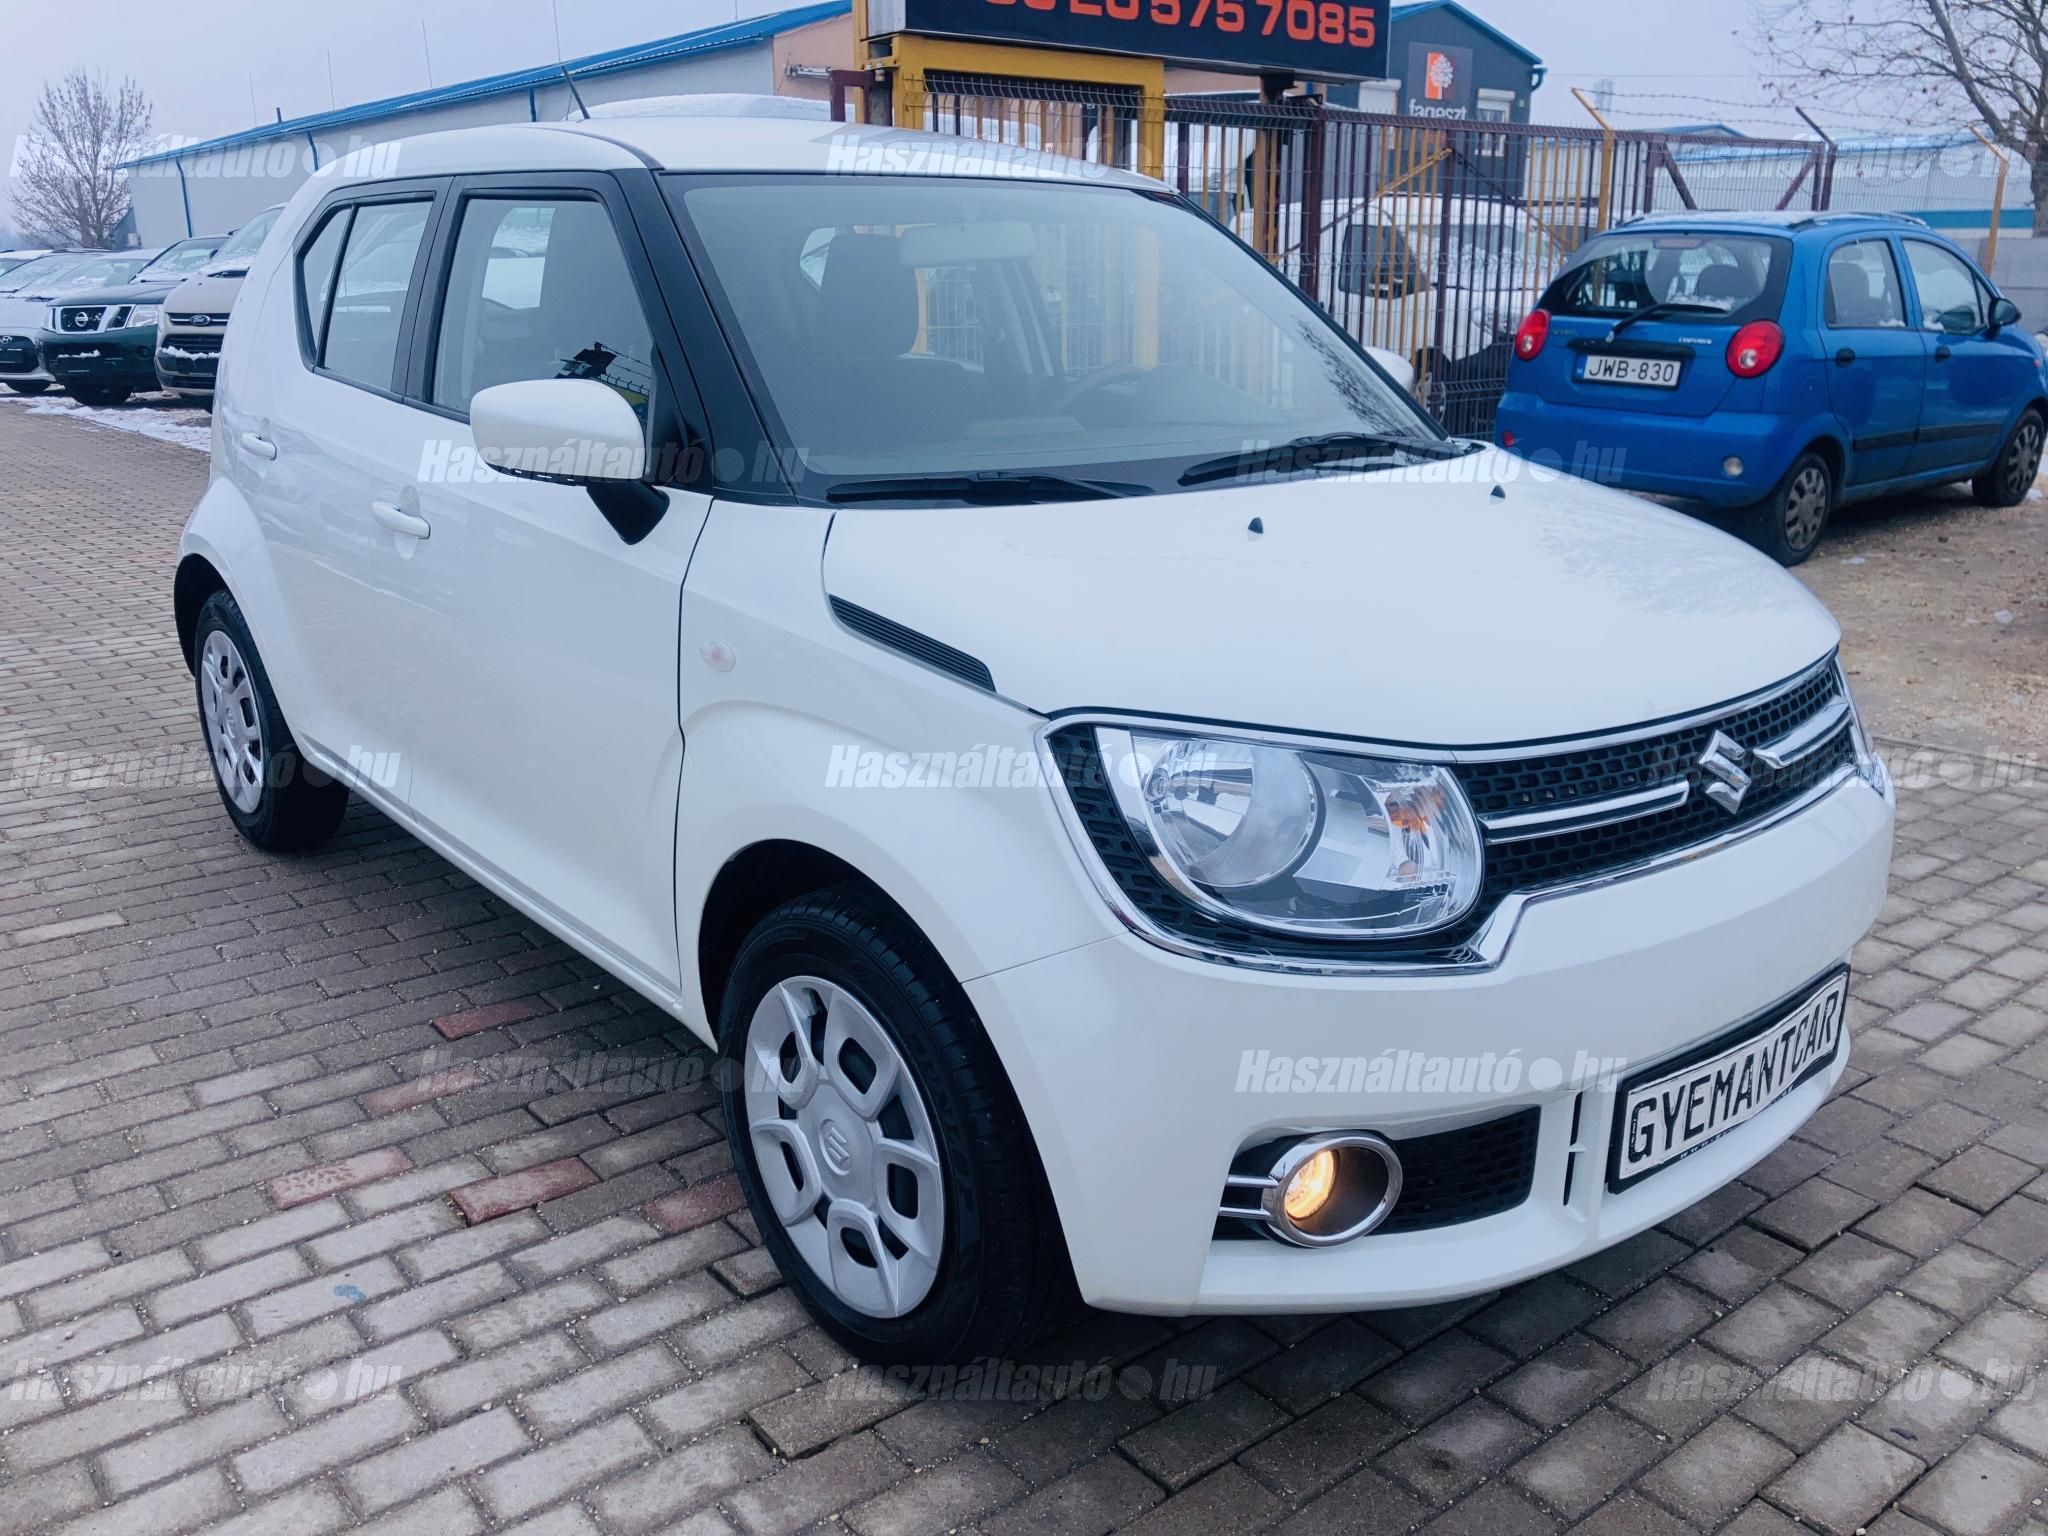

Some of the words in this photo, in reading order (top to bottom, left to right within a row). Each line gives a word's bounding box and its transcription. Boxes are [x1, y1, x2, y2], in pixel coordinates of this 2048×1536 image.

[1151, 0, 1246, 33] 575
[1256, 0, 1376, 48] 7085
[1588, 358, 1675, 383] JWB-830
[1627, 988, 1841, 1164] GYEMANTCAR
